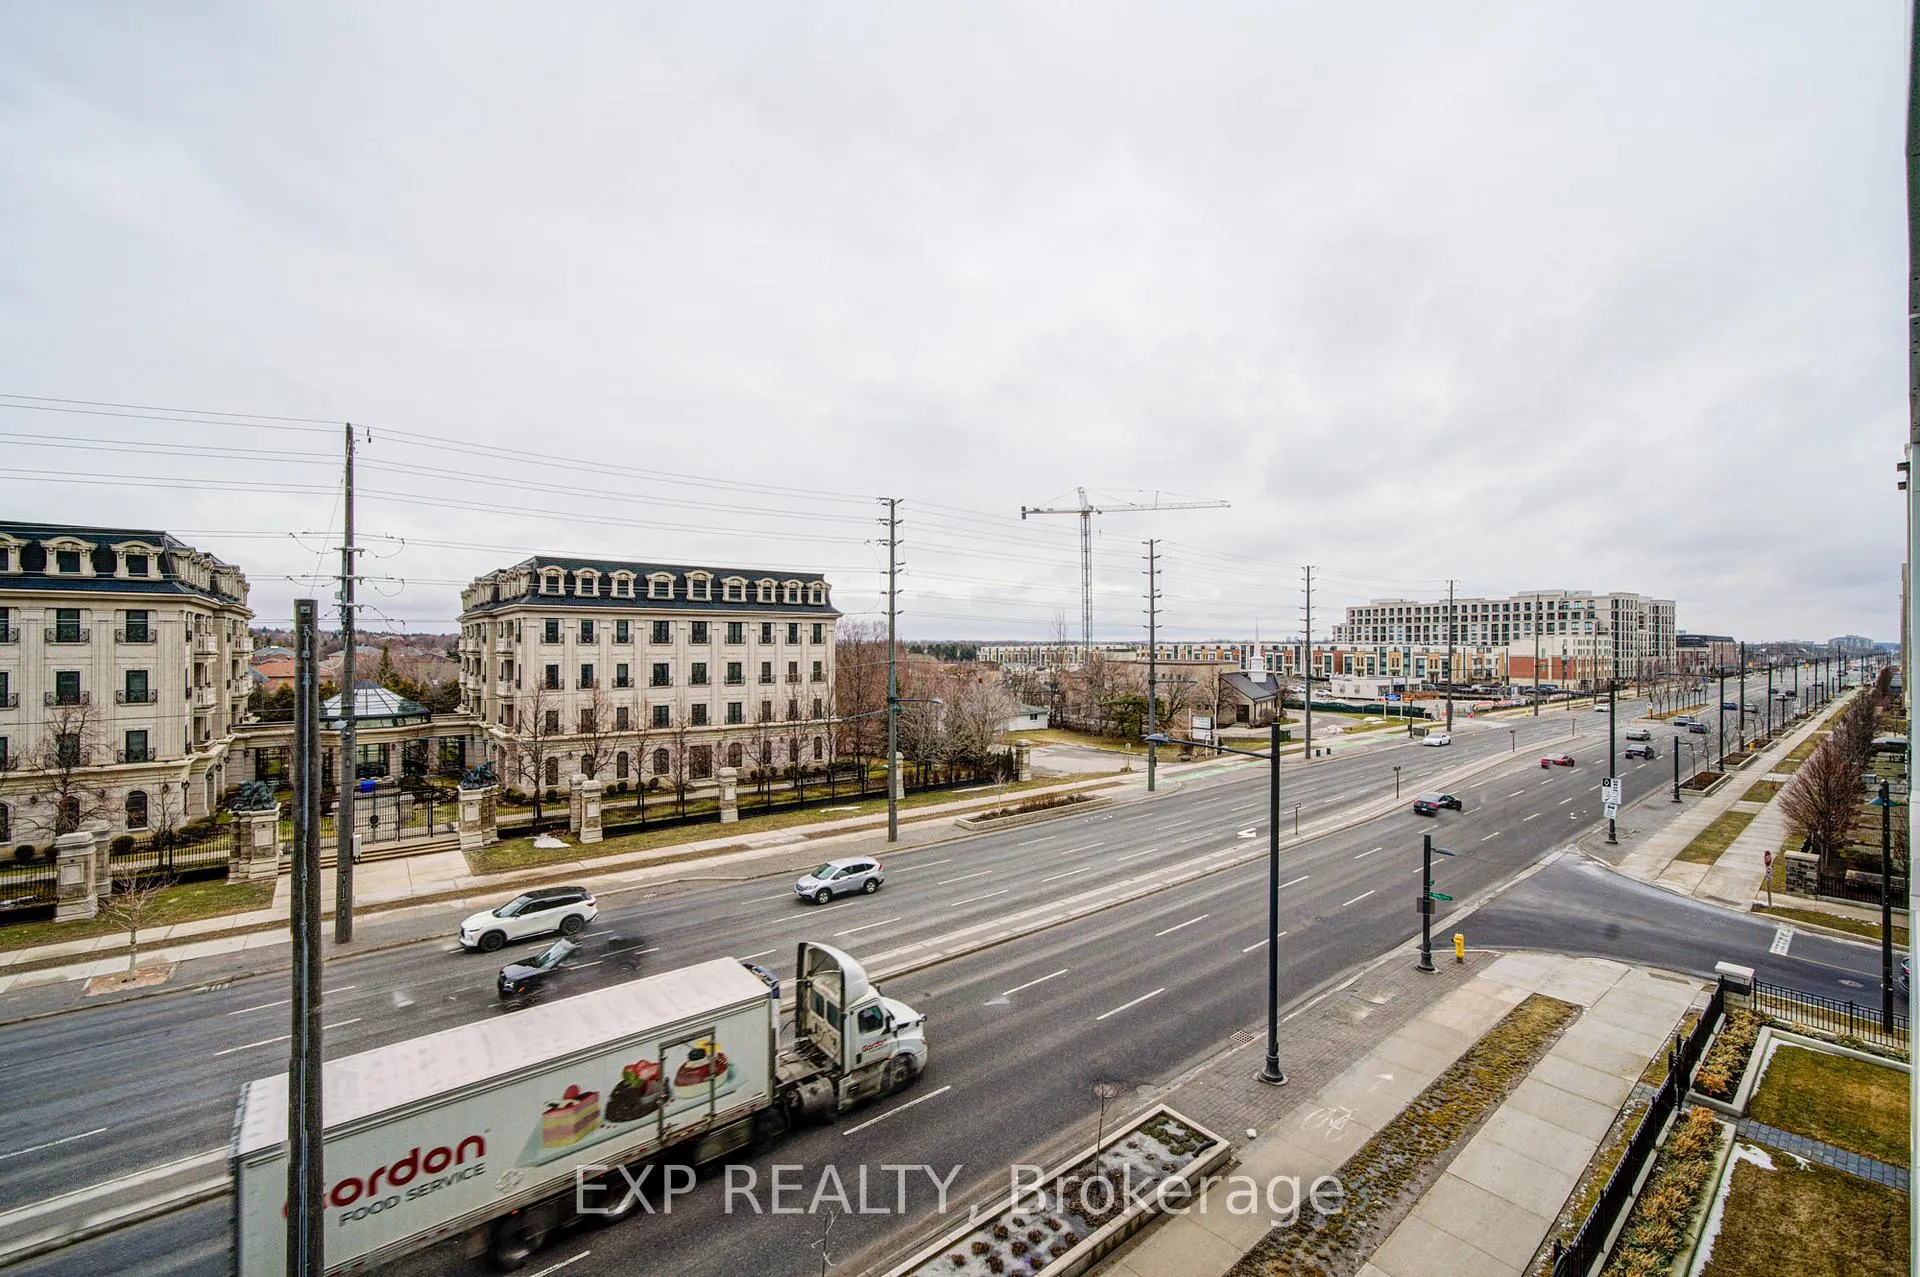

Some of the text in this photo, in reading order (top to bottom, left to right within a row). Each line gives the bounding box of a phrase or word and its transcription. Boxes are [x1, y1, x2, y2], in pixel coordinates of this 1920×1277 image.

[282, 1135, 486, 1219] ordon
[338, 1162, 485, 1227] FOOD SERVICE
